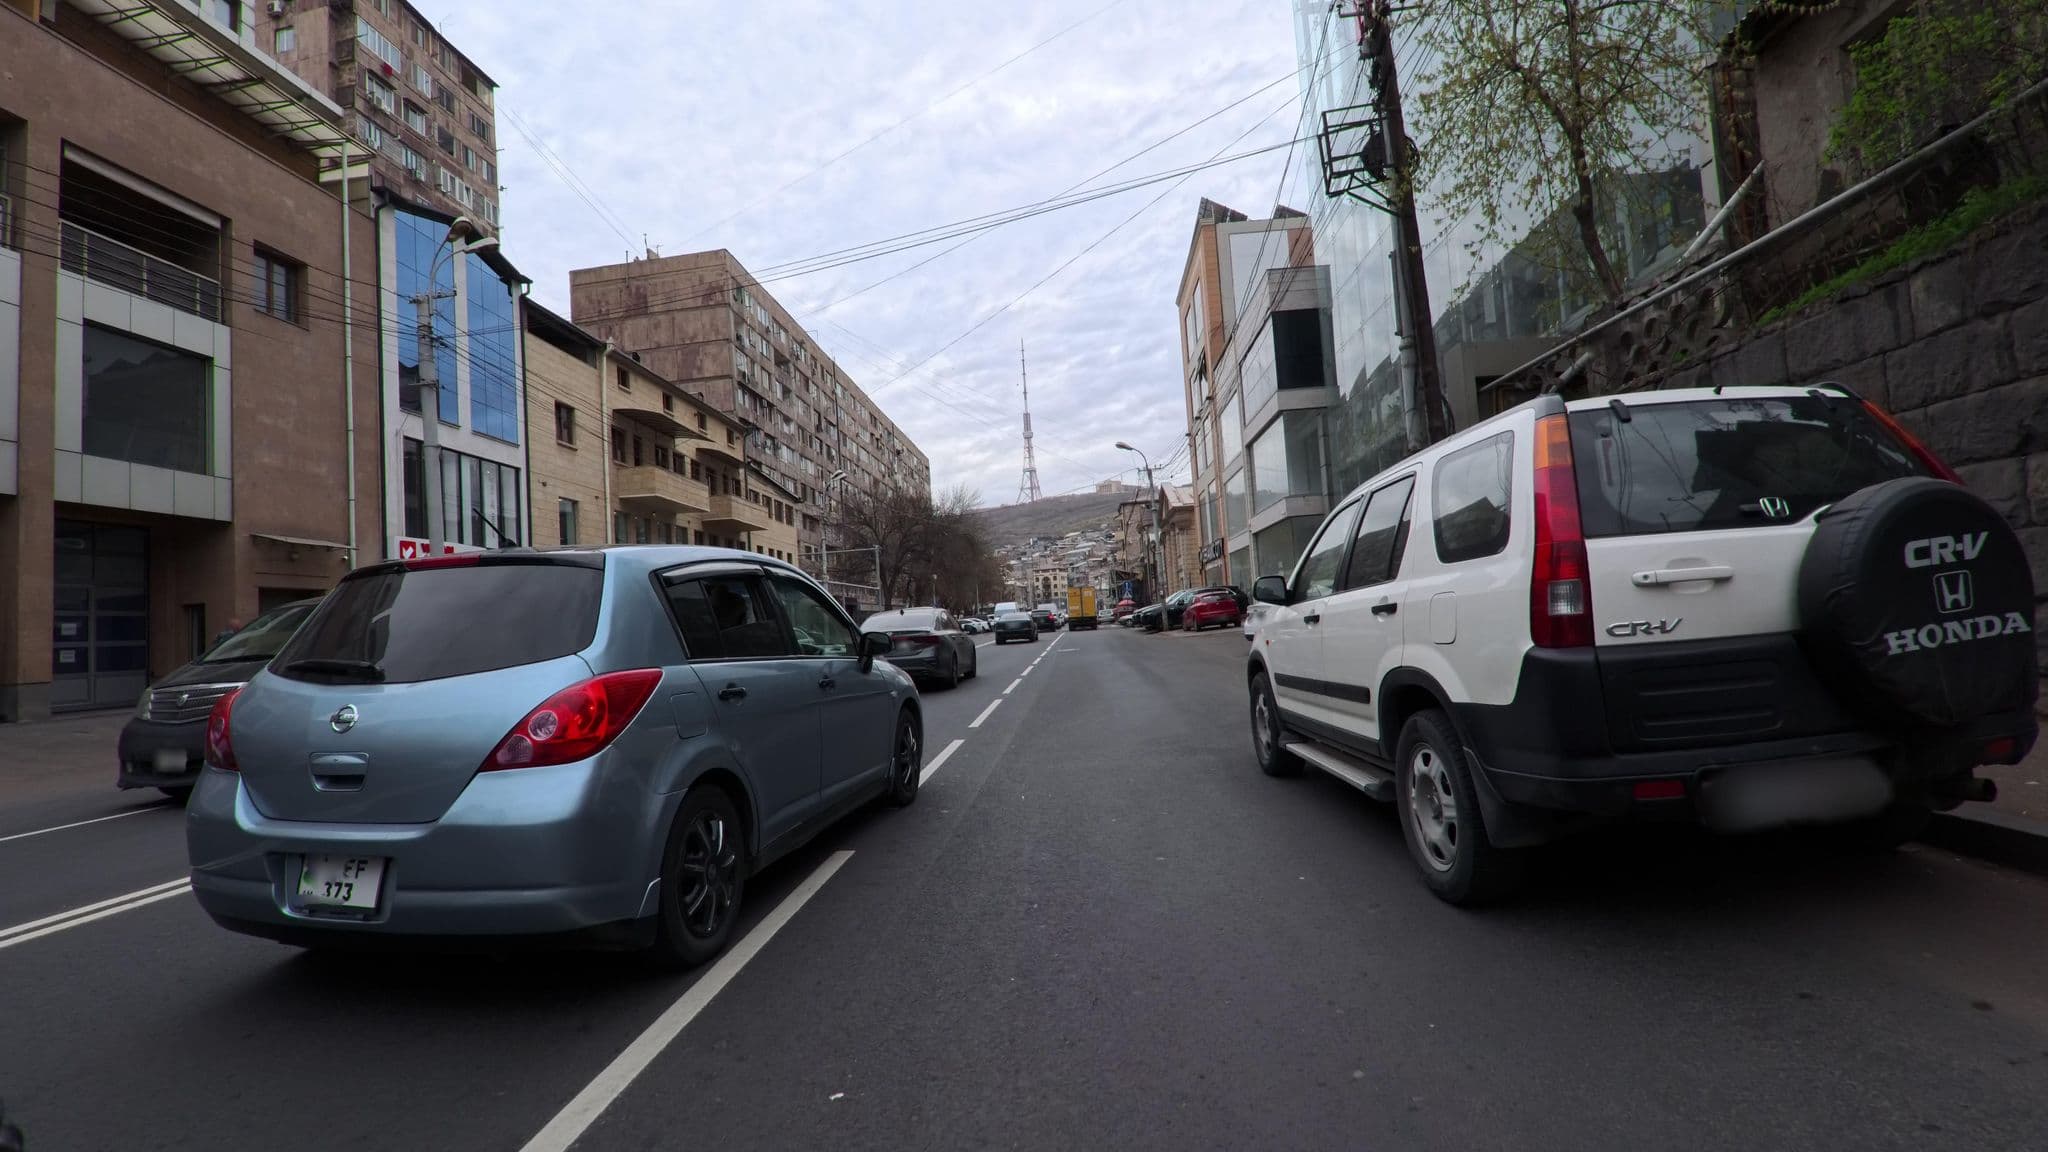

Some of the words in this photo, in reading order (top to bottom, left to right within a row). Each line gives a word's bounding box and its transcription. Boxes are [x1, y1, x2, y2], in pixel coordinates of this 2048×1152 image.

[1904, 531, 1989, 569] CR-V
[1605, 618, 1683, 638] CR-V
[1883, 612, 2032, 656] HONDA
[324, 881, 354, 902] 373
